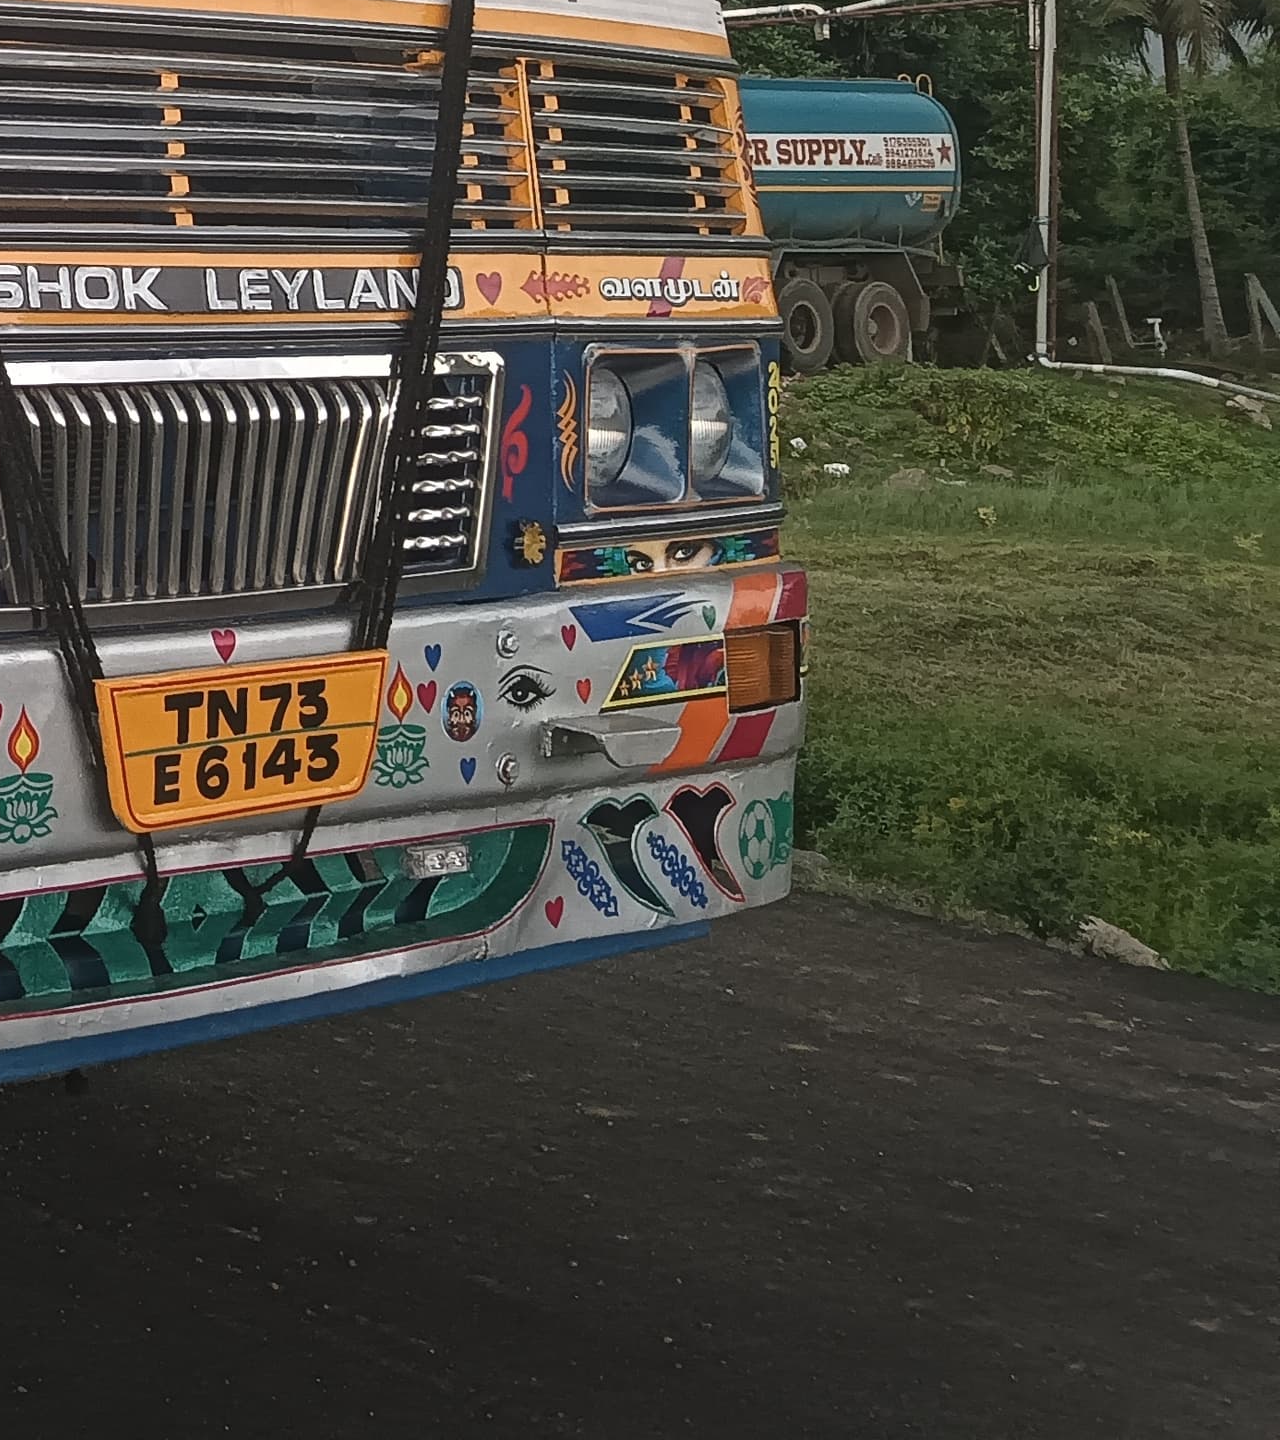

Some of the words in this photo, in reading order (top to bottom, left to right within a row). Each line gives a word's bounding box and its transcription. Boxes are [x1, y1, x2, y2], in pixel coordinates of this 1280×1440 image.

[599, 270, 740, 307] வளமுடன்
[163, 687, 248, 744] TN
[259, 679, 329, 732] 73
